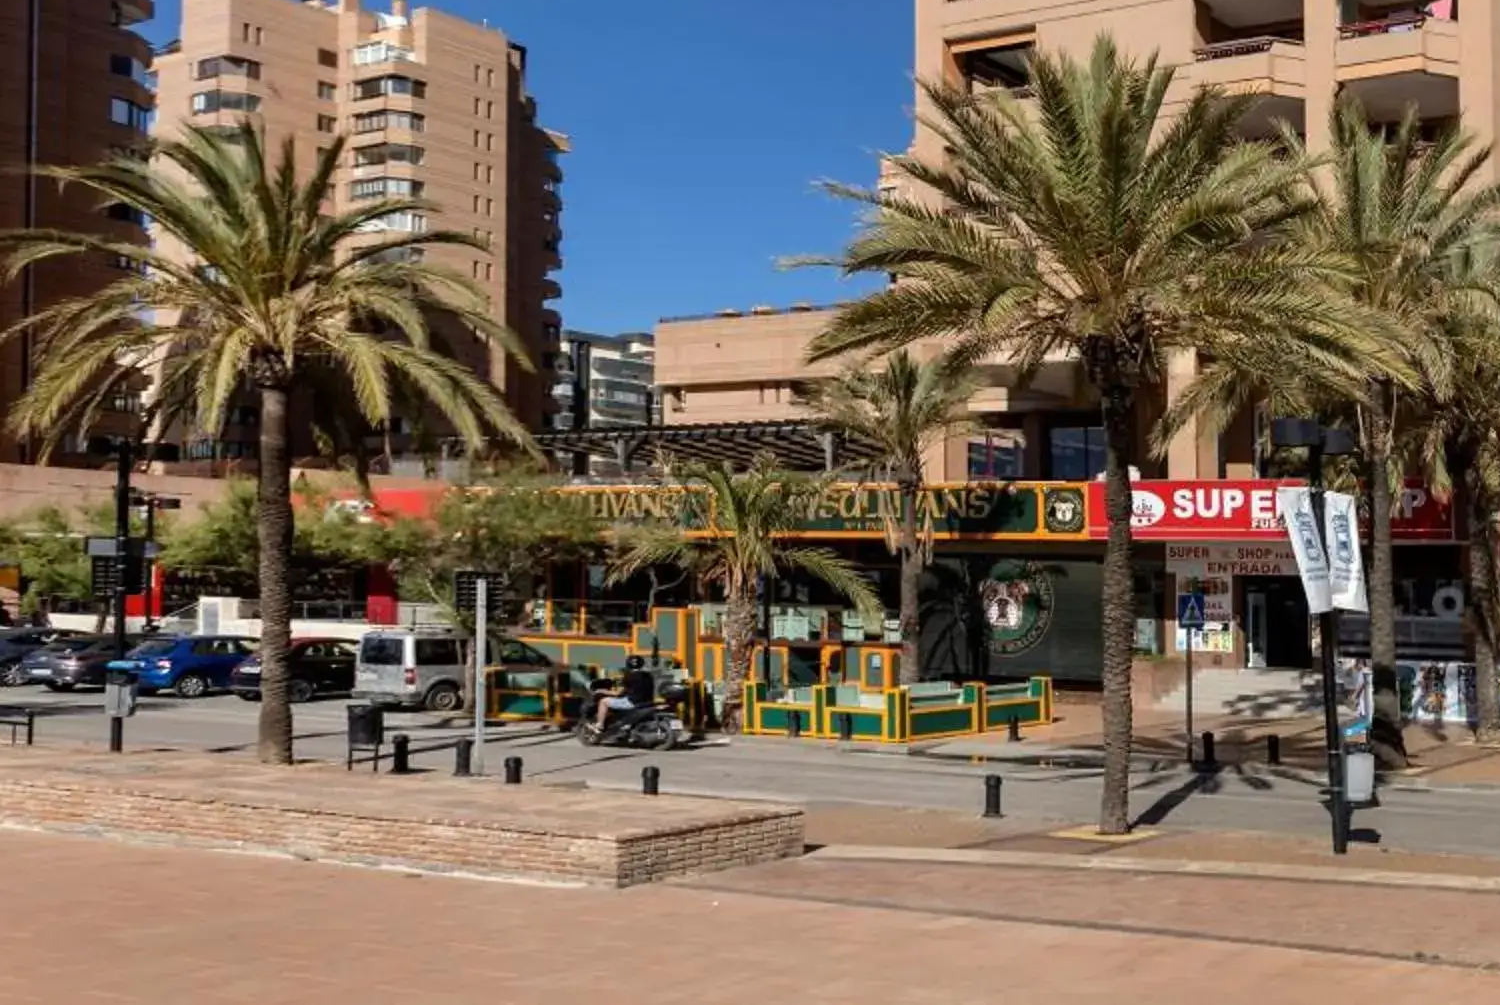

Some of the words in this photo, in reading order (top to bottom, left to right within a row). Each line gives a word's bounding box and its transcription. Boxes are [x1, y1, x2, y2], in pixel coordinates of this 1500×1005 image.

[1169, 546, 1210, 559] SUPER
[1237, 546, 1271, 560] SHOP
[1207, 562, 1281, 574] ENTRADA
